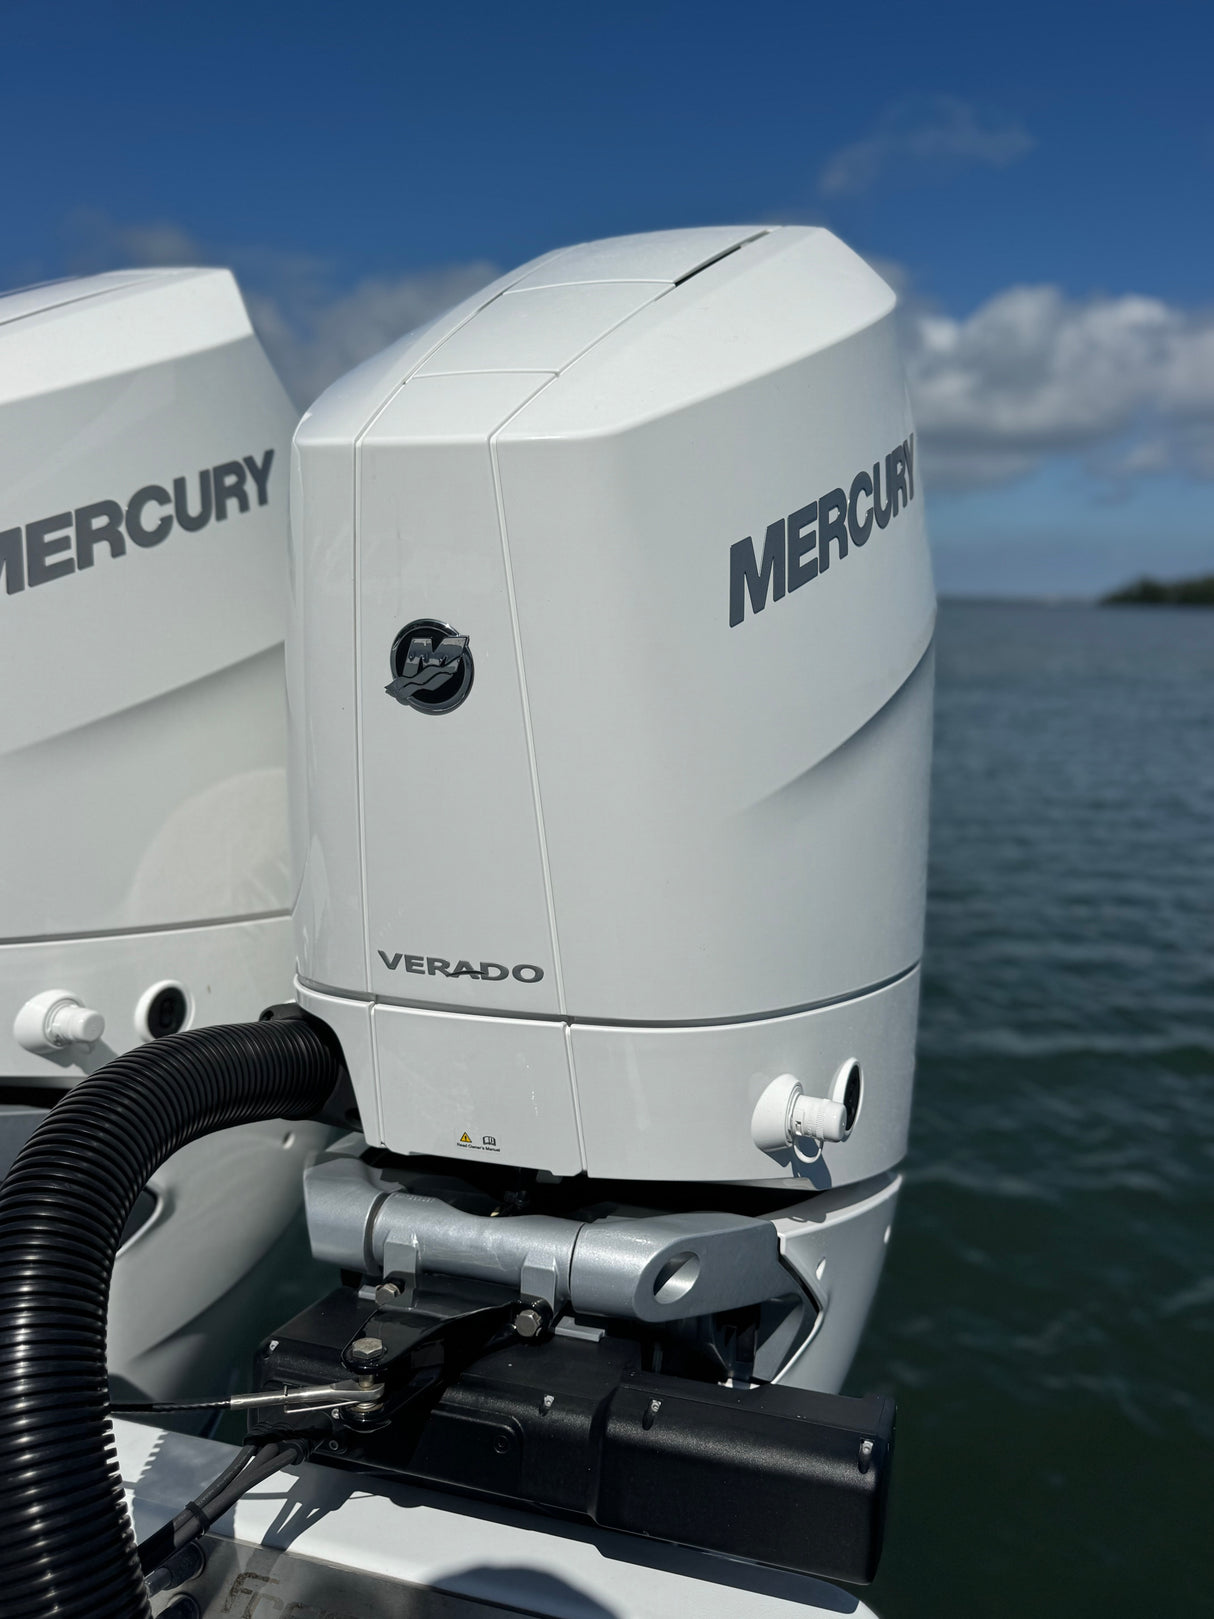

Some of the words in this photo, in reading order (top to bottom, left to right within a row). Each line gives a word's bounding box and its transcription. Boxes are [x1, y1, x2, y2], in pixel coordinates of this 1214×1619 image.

[0, 448, 275, 596] ERCURY
[729, 432, 915, 628] MERCURY
[377, 949, 545, 984] VERADO
